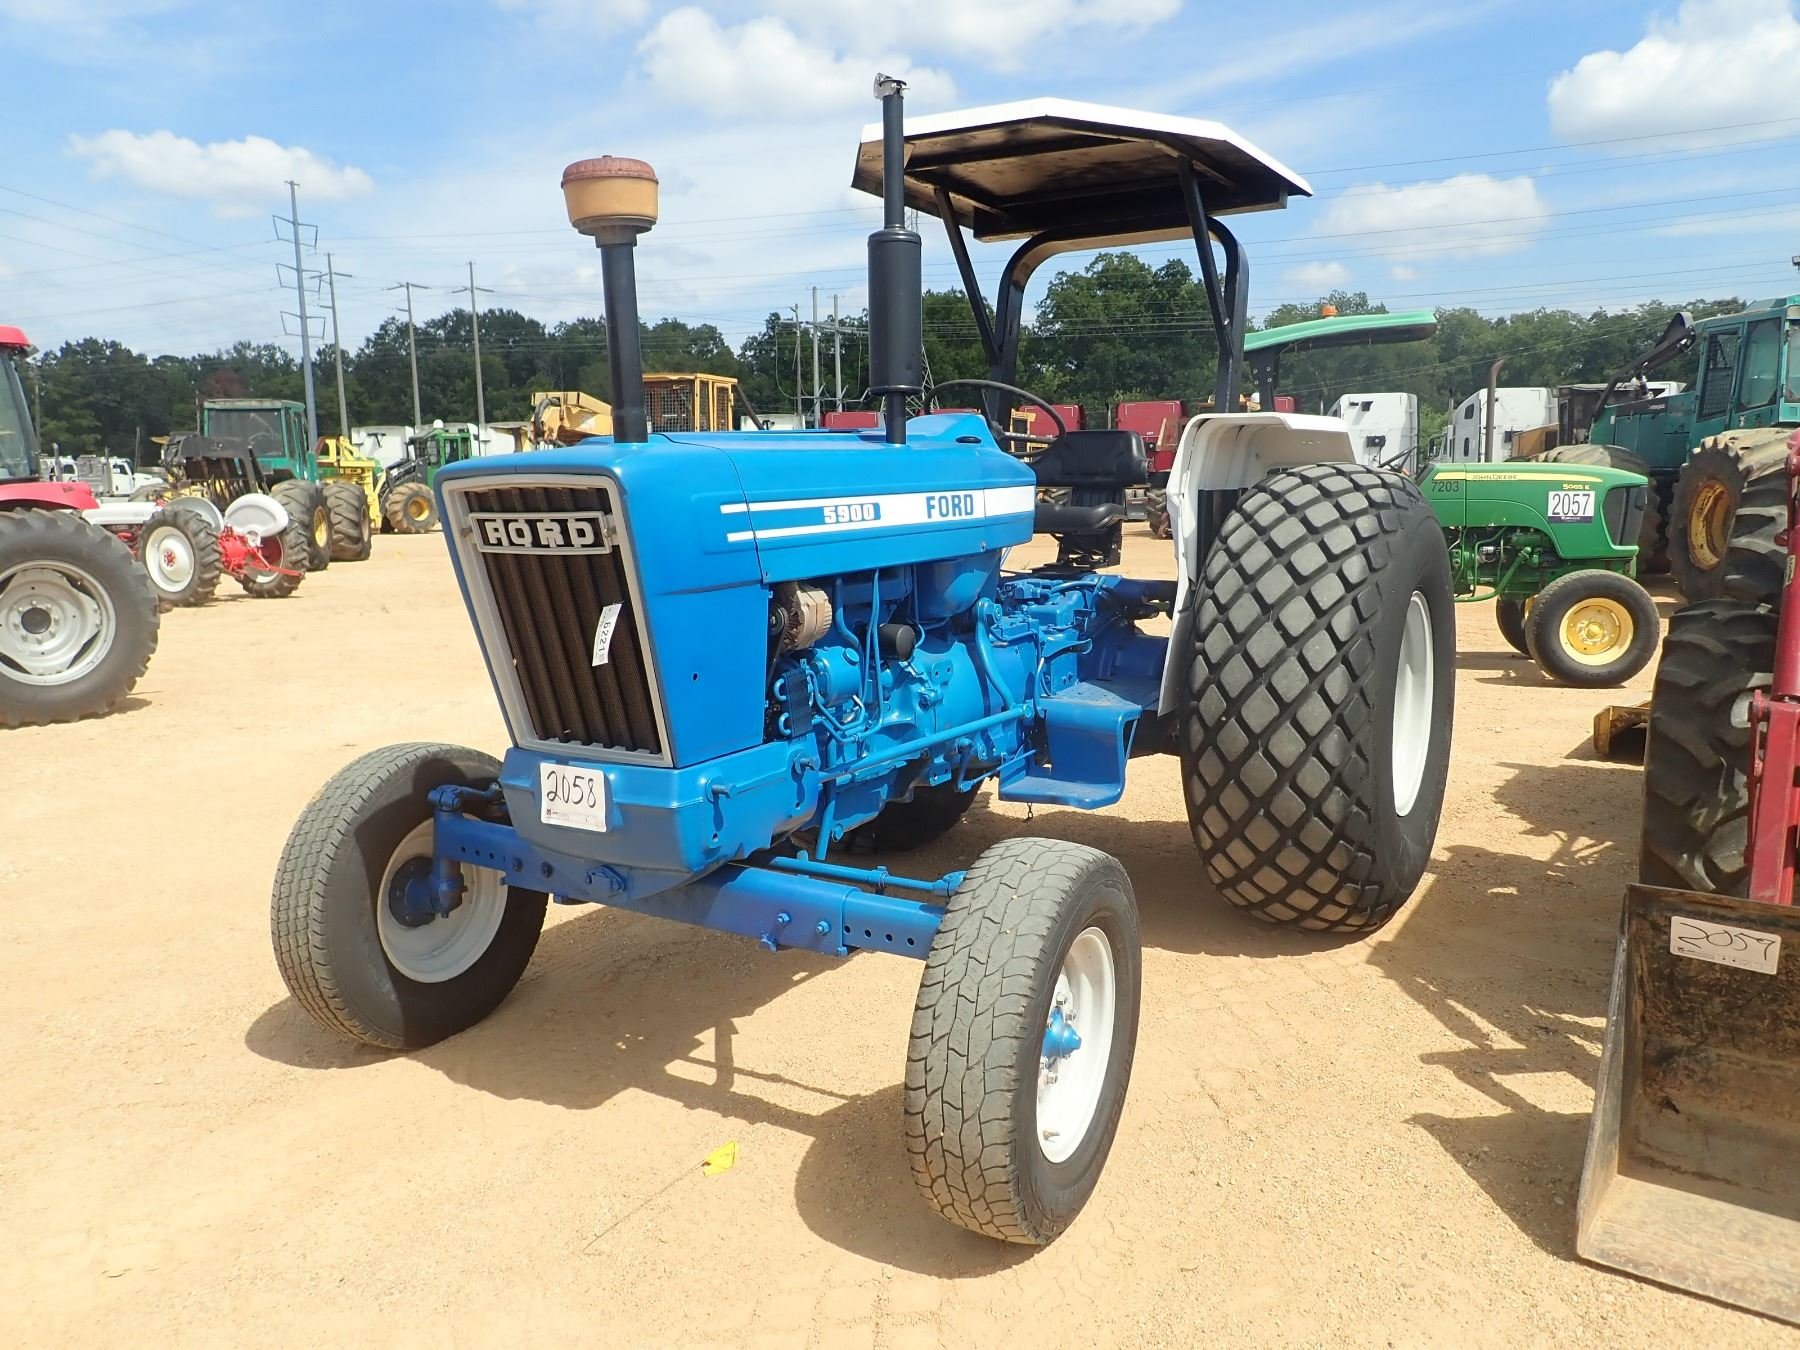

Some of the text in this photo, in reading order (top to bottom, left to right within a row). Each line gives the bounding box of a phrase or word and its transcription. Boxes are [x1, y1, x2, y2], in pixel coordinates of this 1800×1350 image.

[1432, 481, 1460, 492] 7203
[824, 494, 974, 524] 5900 FORD
[1551, 493, 1591, 516] 2057
[546, 770, 597, 809] 2058
